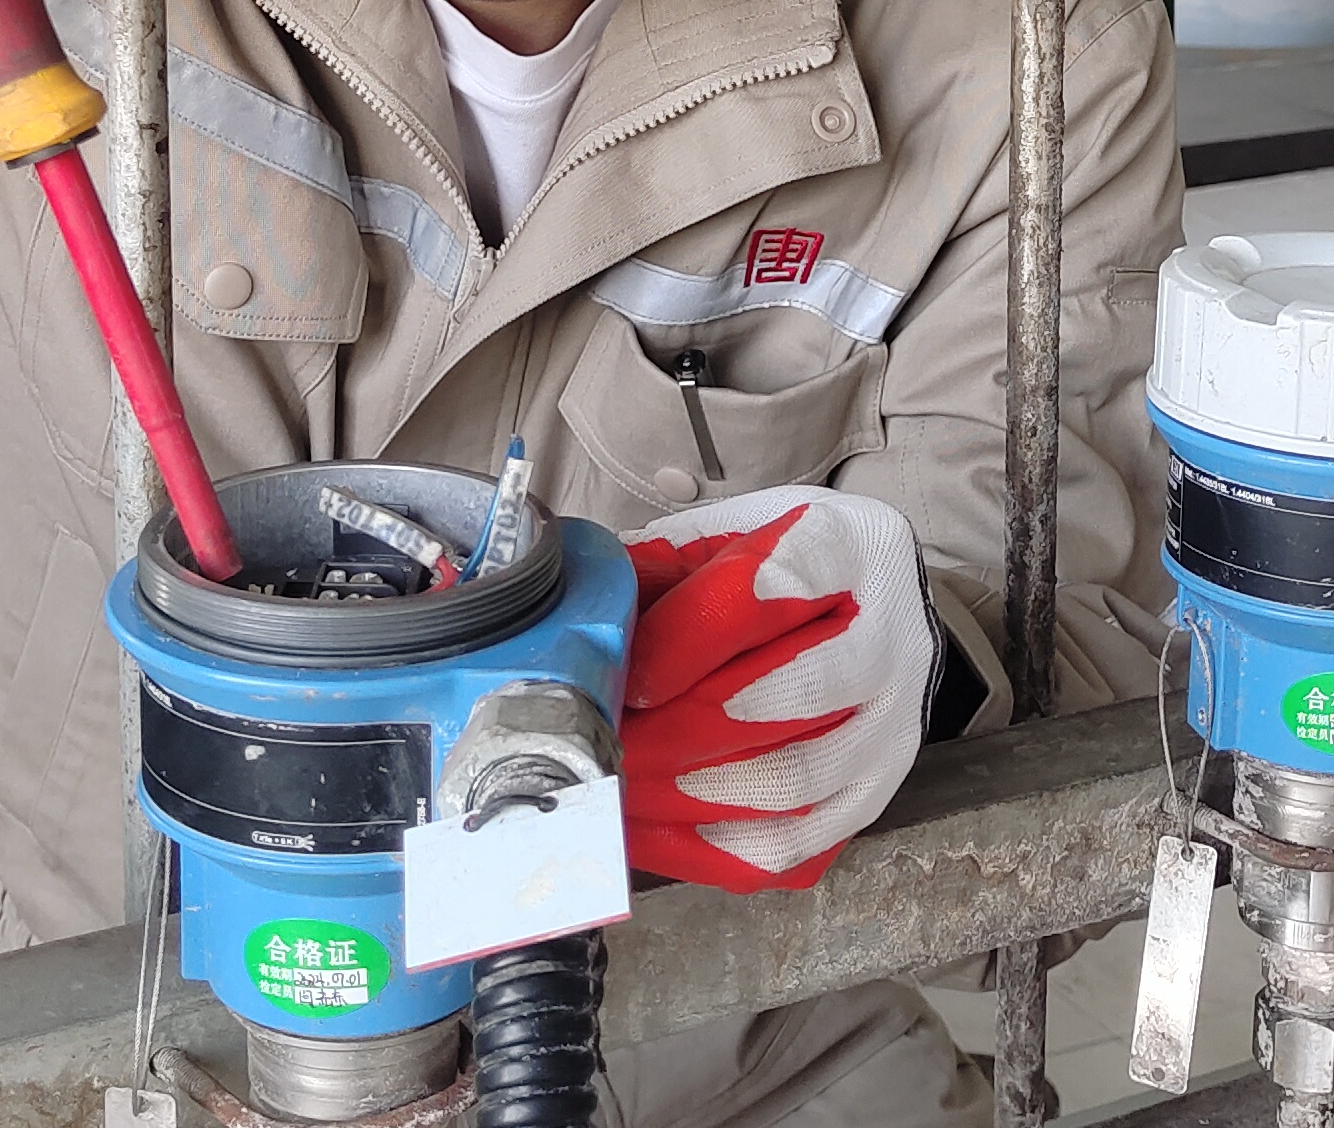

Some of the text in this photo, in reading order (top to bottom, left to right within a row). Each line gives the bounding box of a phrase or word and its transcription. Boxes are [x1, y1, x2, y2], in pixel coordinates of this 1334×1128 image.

[743, 227, 825, 288] 唐
[1296, 712, 1329, 727] 有效期
[264, 934, 358, 967] 合格证
